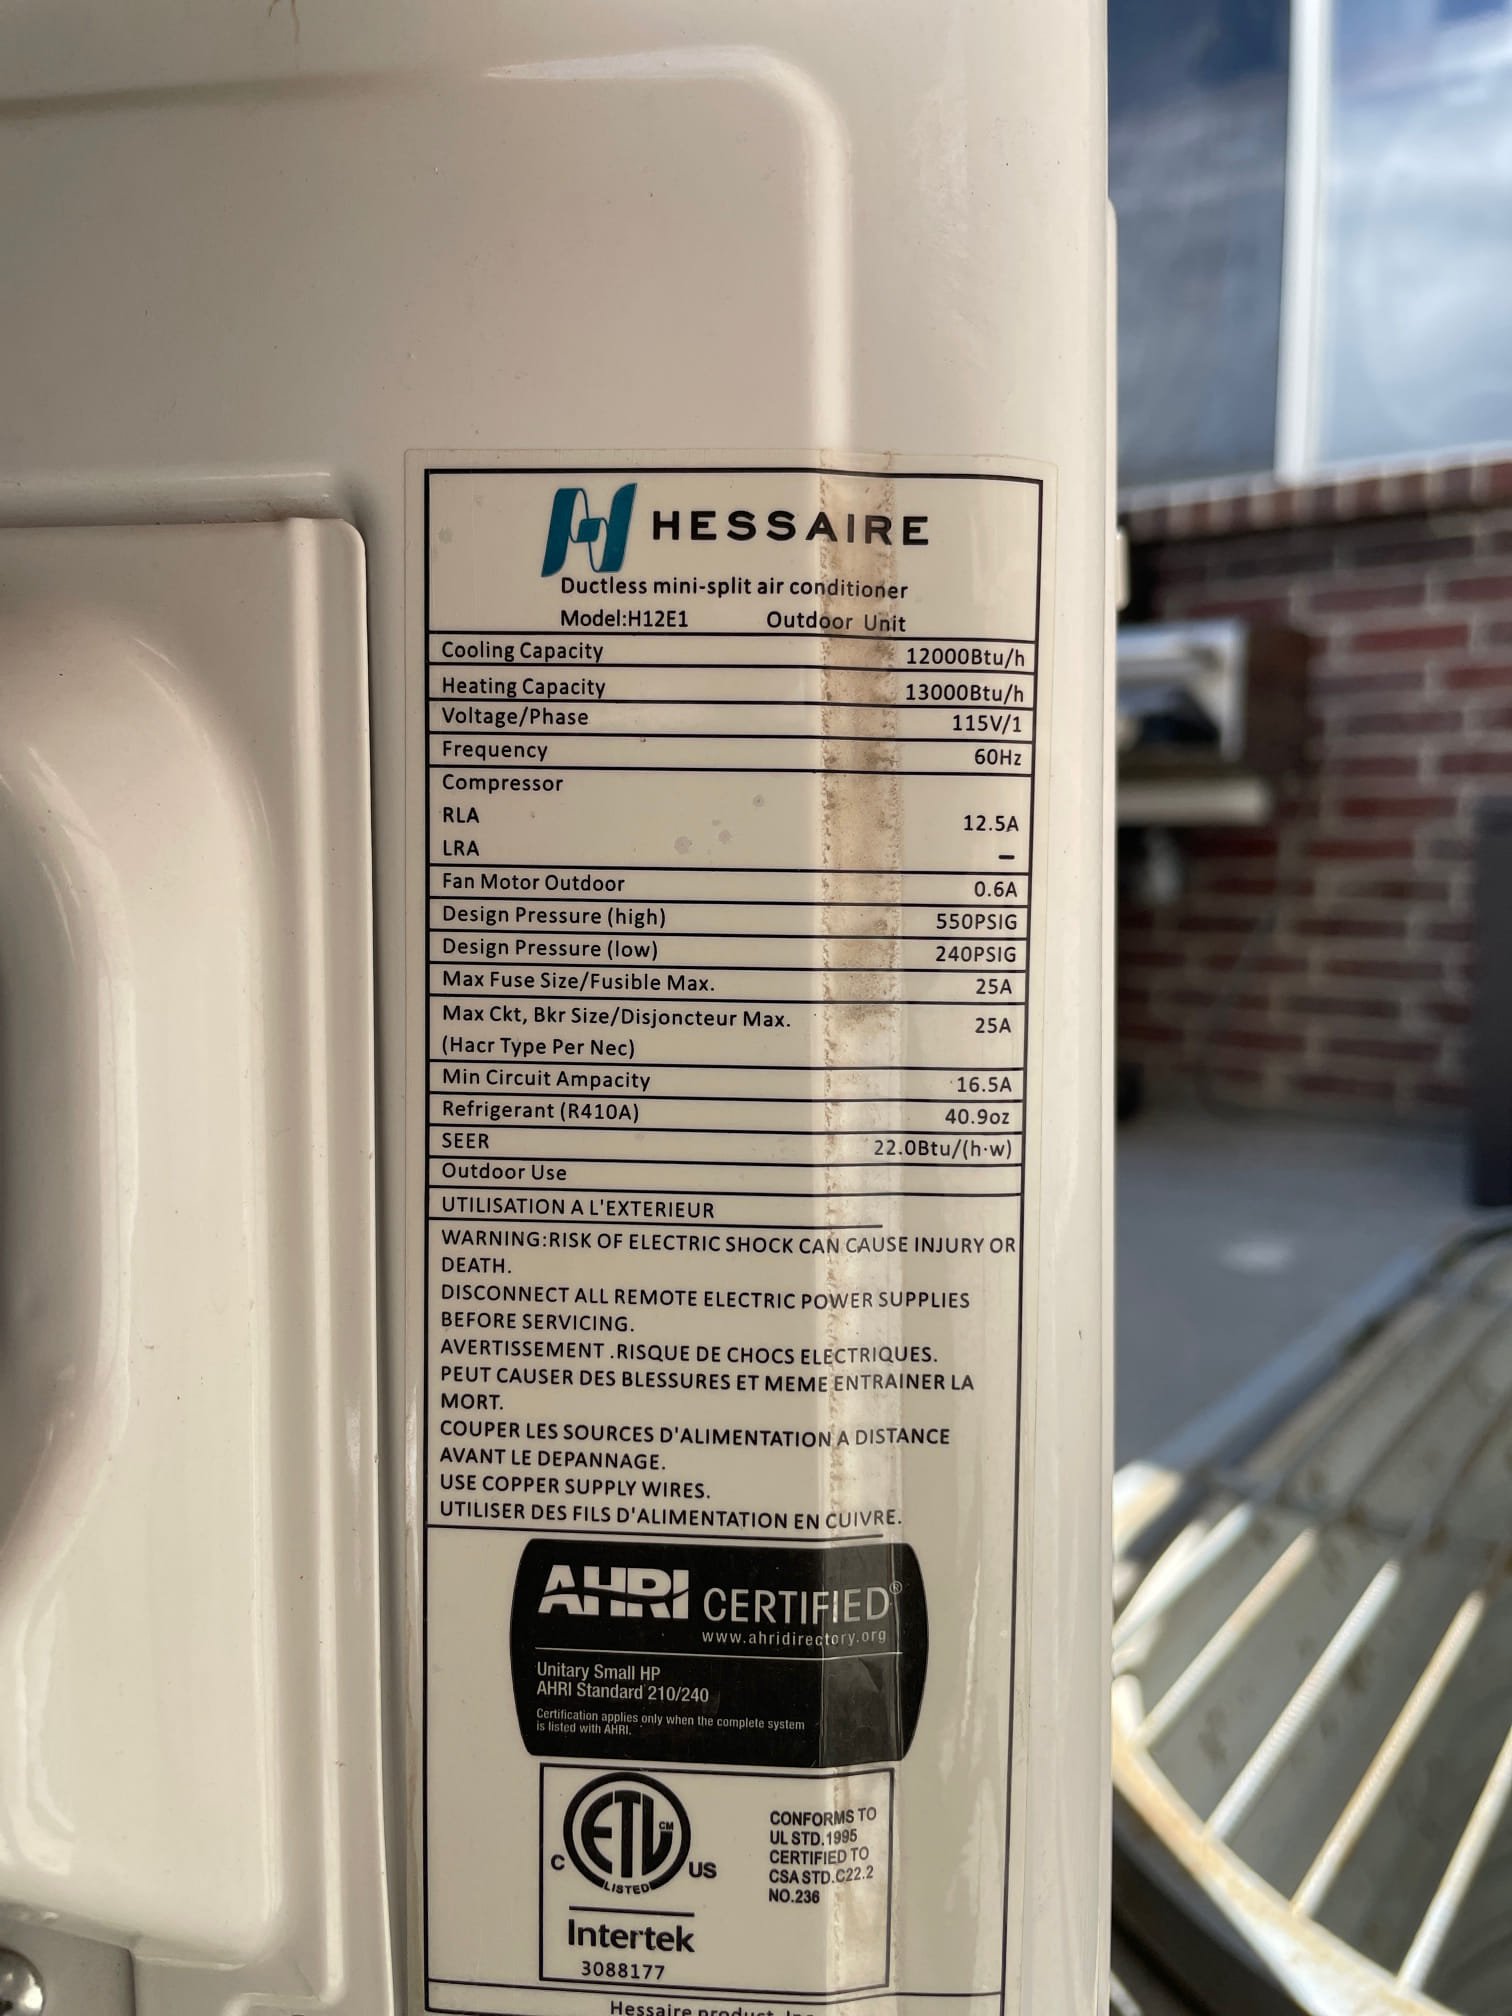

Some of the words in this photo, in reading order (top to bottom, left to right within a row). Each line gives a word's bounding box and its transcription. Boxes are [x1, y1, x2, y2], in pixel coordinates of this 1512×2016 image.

[652, 510, 929, 545] HESSAIRE
[562, 576, 647, 594] Ductless
[654, 576, 751, 598] mini-split
[757, 577, 784, 594] air
[789, 579, 908, 599] conditioner
[561, 609, 688, 627] Model:H12E1
[767, 608, 853, 630] Outdoor
[865, 612, 906, 632] Unit
[442, 641, 515, 663] Cooling
[520, 641, 603, 663] Capacity
[907, 648, 1024, 669] 12000Btu/h
[442, 677, 518, 699] Heating
[522, 678, 606, 699] Capacity
[906, 683, 1023, 705] 13000Btu/h
[442, 706, 588, 728] Voltage/Phase
[953, 714, 1021, 735] 115V/1
[443, 740, 548, 762] Frequency
[975, 748, 1022, 766] 60Hz
[443, 774, 563, 794] Compressor
[443, 807, 479, 823] RLA
[964, 815, 1019, 832] 12.5A
[443, 840, 479, 856] LRA
[443, 873, 474, 889] Fan
[481, 873, 540, 890] Motor
[545, 874, 625, 892] Outdoor
[974, 881, 1018, 898] 0.6A
[443, 905, 509, 926] Design
[516, 907, 601, 924] Pressure
[608, 907, 665, 929] (high)
[936, 913, 1017, 930] 550PSIG
[443, 938, 508, 958] Design
[516, 939, 601, 957] Pressure
[608, 940, 657, 962] (low)
[936, 946, 1016, 963] 240PSIG
[443, 970, 484, 987] Max
[490, 971, 535, 988] Fuse
[540, 971, 661, 992] Size/Fusible
[668, 975, 714, 991] Max.
[976, 978, 1012, 995] 25A
[443, 1005, 484, 1021] Max
[490, 1005, 527, 1025] Ckt,
[534, 1006, 566, 1023] Bkr
[571, 1006, 737, 1029] Size/Disjoncteur
[744, 1011, 790, 1027] Max.
[975, 1017, 1012, 1034] 25A
[443, 1035, 495, 1056] (Hacr
[500, 1037, 546, 1058] Type
[553, 1039, 584, 1055] Per
[591, 1039, 634, 1060] Nec)
[443, 1068, 480, 1084] Min
[486, 1069, 551, 1086] Circuit
[556, 1071, 650, 1092] Ampacity
[957, 1076, 1012, 1093] 16.5A
[443, 1100, 554, 1121] Refrigerant
[561, 1102, 638, 1124] (R410A)
[945, 1108, 1010, 1125] 40.9oz
[442, 1132, 489, 1149] SEER
[442, 1162, 526, 1179] Outdoor
[532, 1164, 566, 1181] Use
[443, 1196, 564, 1214] UTILISATION
[571, 1200, 584, 1215] A
[590, 1199, 714, 1219] L'EXTERIEUR
[442, 1229, 591, 1248] WARNING:RISK
[597, 1233, 623, 1249] OF
[630, 1234, 720, 1252] ELECTRIC
[726, 1236, 793, 1254] SHOCK
[798, 1238, 840, 1255] CAN
[846, 1236, 908, 1253] CAUSE
[915, 1237, 984, 1253] INJURY
[990, 1237, 1015, 1253] OR
[442, 1257, 511, 1274] DEATH.
[442, 1284, 570, 1303] DISCONNECT
[574, 1288, 608, 1304] ALL
[615, 1289, 697, 1306] REMOTE
[704, 1291, 795, 1309] ELECTRIC
[802, 1292, 872, 1310] POWER
[878, 1291, 970, 1308] SUPPLIES
[442, 1311, 516, 1329] BEFORE
[522, 1314, 634, 1332] SERVICING.
[440, 1338, 605, 1359] AVERTISSEMENT
[697, 1346, 720, 1362] DE
[727, 1347, 795, 1365] CHOCS
[801, 1346, 937, 1370] ELECTRIQUES.
[441, 1366, 492, 1383] PEUT
[497, 1368, 573, 1385] CAUSER
[580, 1370, 616, 1386] DES
[622, 1371, 730, 1390] BLESSURES
[737, 1374, 759, 1391] ET
[765, 1375, 828, 1392] MEME
[834, 1374, 945, 1393] ENTRAINER
[951, 1374, 974, 1390] LA
[441, 1393, 503, 1410] MORT.
[440, 1420, 520, 1438] COUPER
[527, 1422, 558, 1439] LES
[563, 1424, 654, 1443] SOURCES
[660, 1424, 834, 1448] D'ALIMENTATION
[837, 1429, 850, 1446] A
[856, 1427, 950, 1445] DISTANCE
[440, 1447, 506, 1464] AVANT
[512, 1450, 533, 1467] LE
[538, 1450, 665, 1470] DEPANNAGE.
[441, 1474, 476, 1491] USE
[482, 1475, 559, 1494] COPPER
[565, 1478, 637, 1496] SUPPLY
[642, 1481, 710, 1499] WIRES.
[441, 1500, 525, 1519] UTILISER
[532, 1504, 567, 1520] DES
[573, 1505, 611, 1523] FILS
[617, 1507, 787, 1528] D'ALIMENTATION
[794, 1513, 819, 1530] EN
[826, 1509, 902, 1530] CUIVRE.
[538, 1564, 690, 1620] AHRI
[702, 1631, 885, 1648] www.ahridirectory.org
[538, 1661, 589, 1681] Unitary
[594, 1664, 635, 1680] Small
[641, 1666, 660, 1681] HP
[537, 1682, 572, 1697] AHRI
[577, 1682, 643, 1699] Standard
[648, 1686, 709, 1702] 210/240
[537, 1708, 598, 1721] Certification
[602, 1712, 638, 1724] applies
[640, 1714, 662, 1727] only
[666, 1715, 694, 1725] when
[698, 1716, 713, 1726] the
[717, 1718, 764, 1730] complete
[768, 1720, 804, 1731] system
[537, 1721, 545, 1731] is
[549, 1721, 576, 1732] listed
[580, 1723, 601, 1733] with
[604, 1724, 631, 1735] AHRI.
[770, 1808, 854, 1827] CONFORMS
[858, 1807, 877, 1822] TO
[770, 1849, 847, 1866] CERTIFIED
[850, 1846, 869, 1862] TO
[688, 1862, 718, 1880] US
[603, 1882, 650, 1895] LISTED
[769, 1888, 820, 1904] NO.236
[568, 1918, 695, 1954] Intertek
[581, 1961, 665, 1980] 3088177
